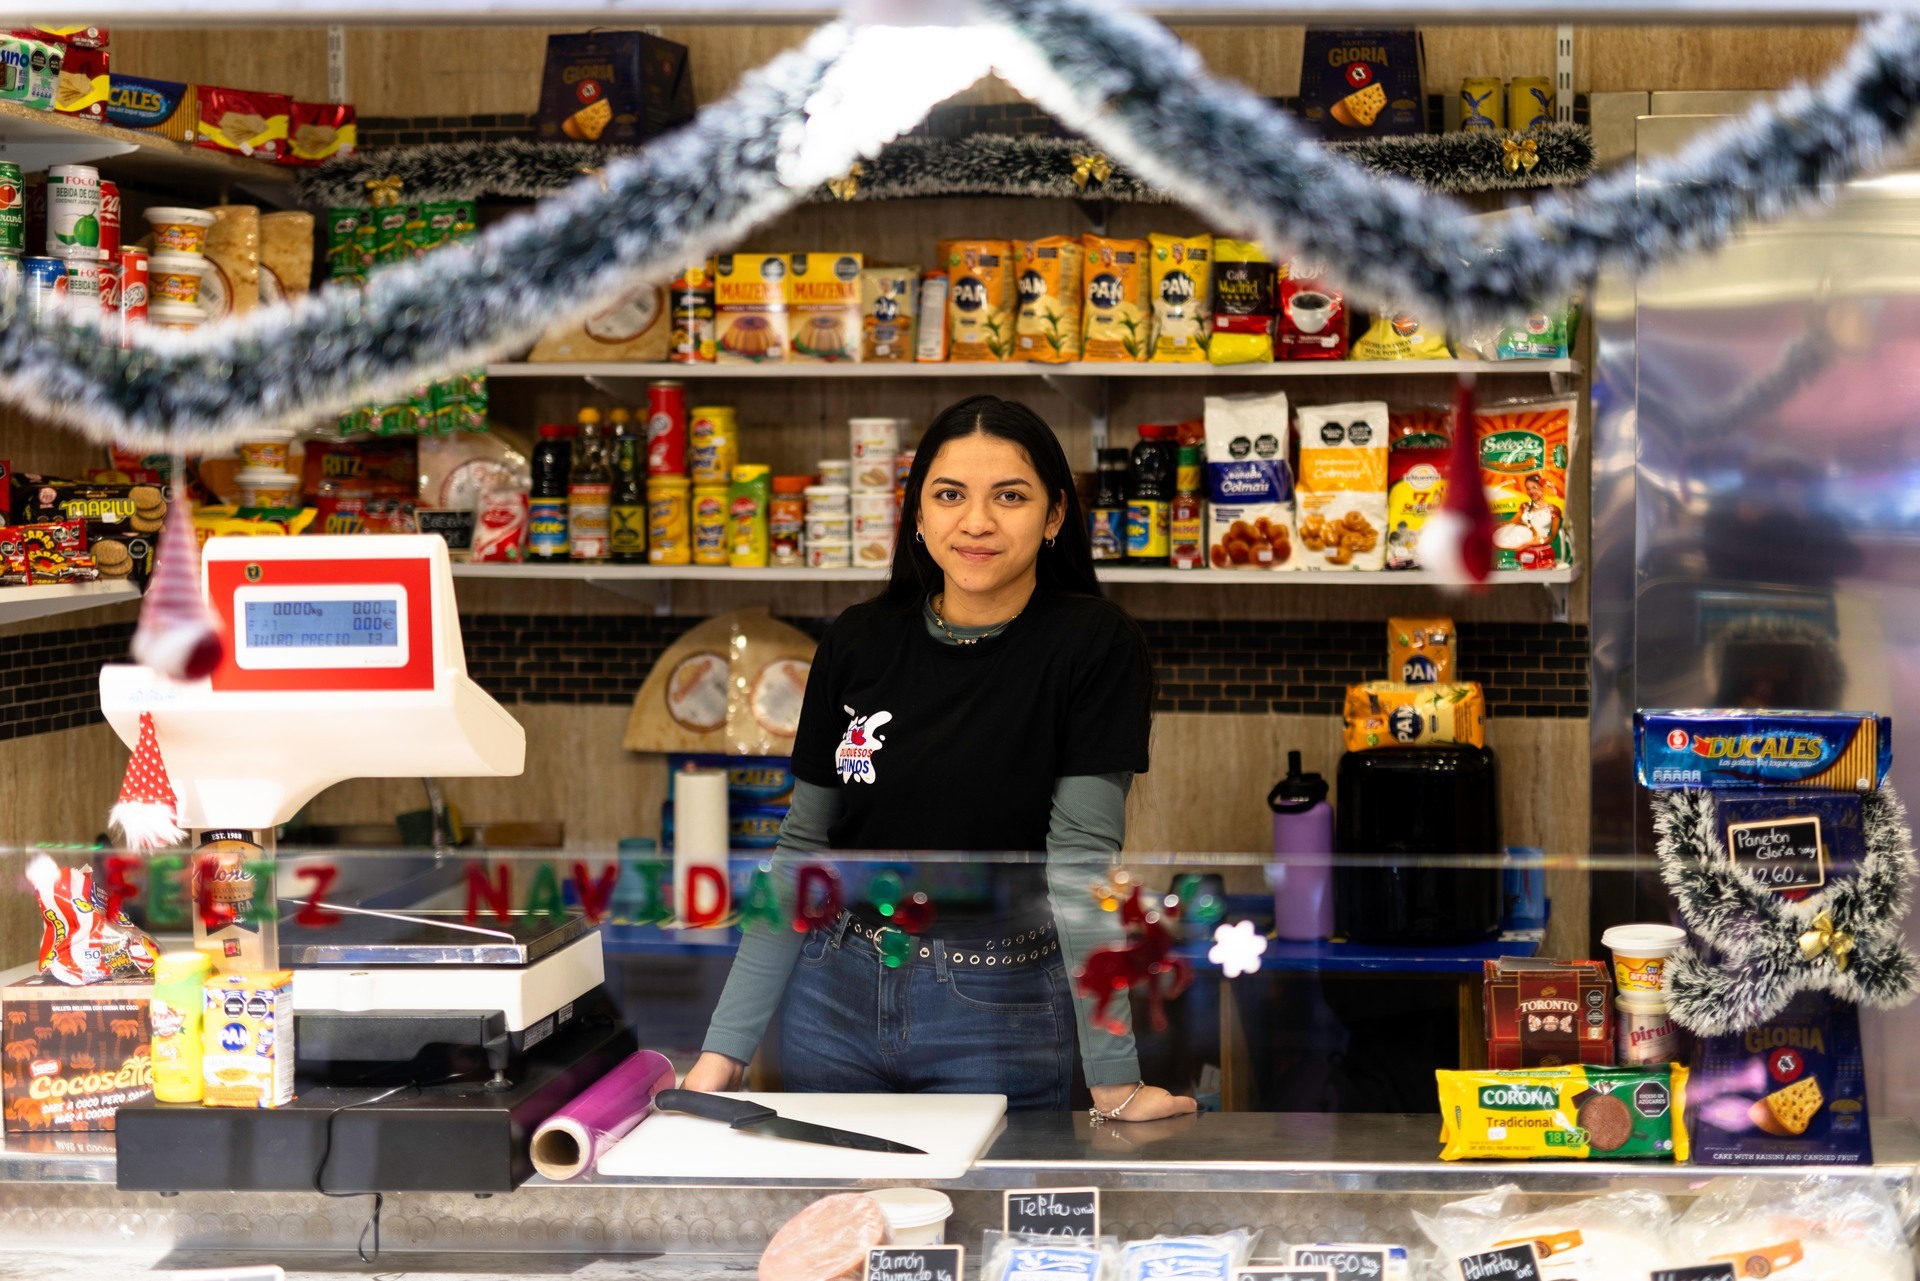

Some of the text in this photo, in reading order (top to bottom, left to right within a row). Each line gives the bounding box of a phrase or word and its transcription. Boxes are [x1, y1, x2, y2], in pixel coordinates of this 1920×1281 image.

[1328, 47, 1389, 67] GLORIA
[65, 176, 96, 187] FOCO
[56, 187, 78, 198] BEBIDA
[79, 188, 87, 198] DE
[321, 454, 364, 477] RITZ
[301, 632, 350, 647] PRECIO
[1706, 737, 1824, 760] DUCALES
[1755, 846, 1796, 860] Gloria
[104, 855, 844, 934] FELIZ NAVIDAD
[84, 950, 101, 960] 50
[1520, 1000, 1578, 1013] TORONTO
[1744, 1026, 1825, 1054] GLORIA
[66, 1100, 74, 1110] A
[75, 1099, 99, 1110] COCO
[101, 1094, 126, 1106] PERO
[1482, 1089, 1555, 1106] CORONA
[76, 1112, 83, 1122] A
[1486, 1116, 1553, 1128] Tradicional
[1548, 1132, 1582, 1144] 18 27
[870, 1250, 925, 1272] Jamón
